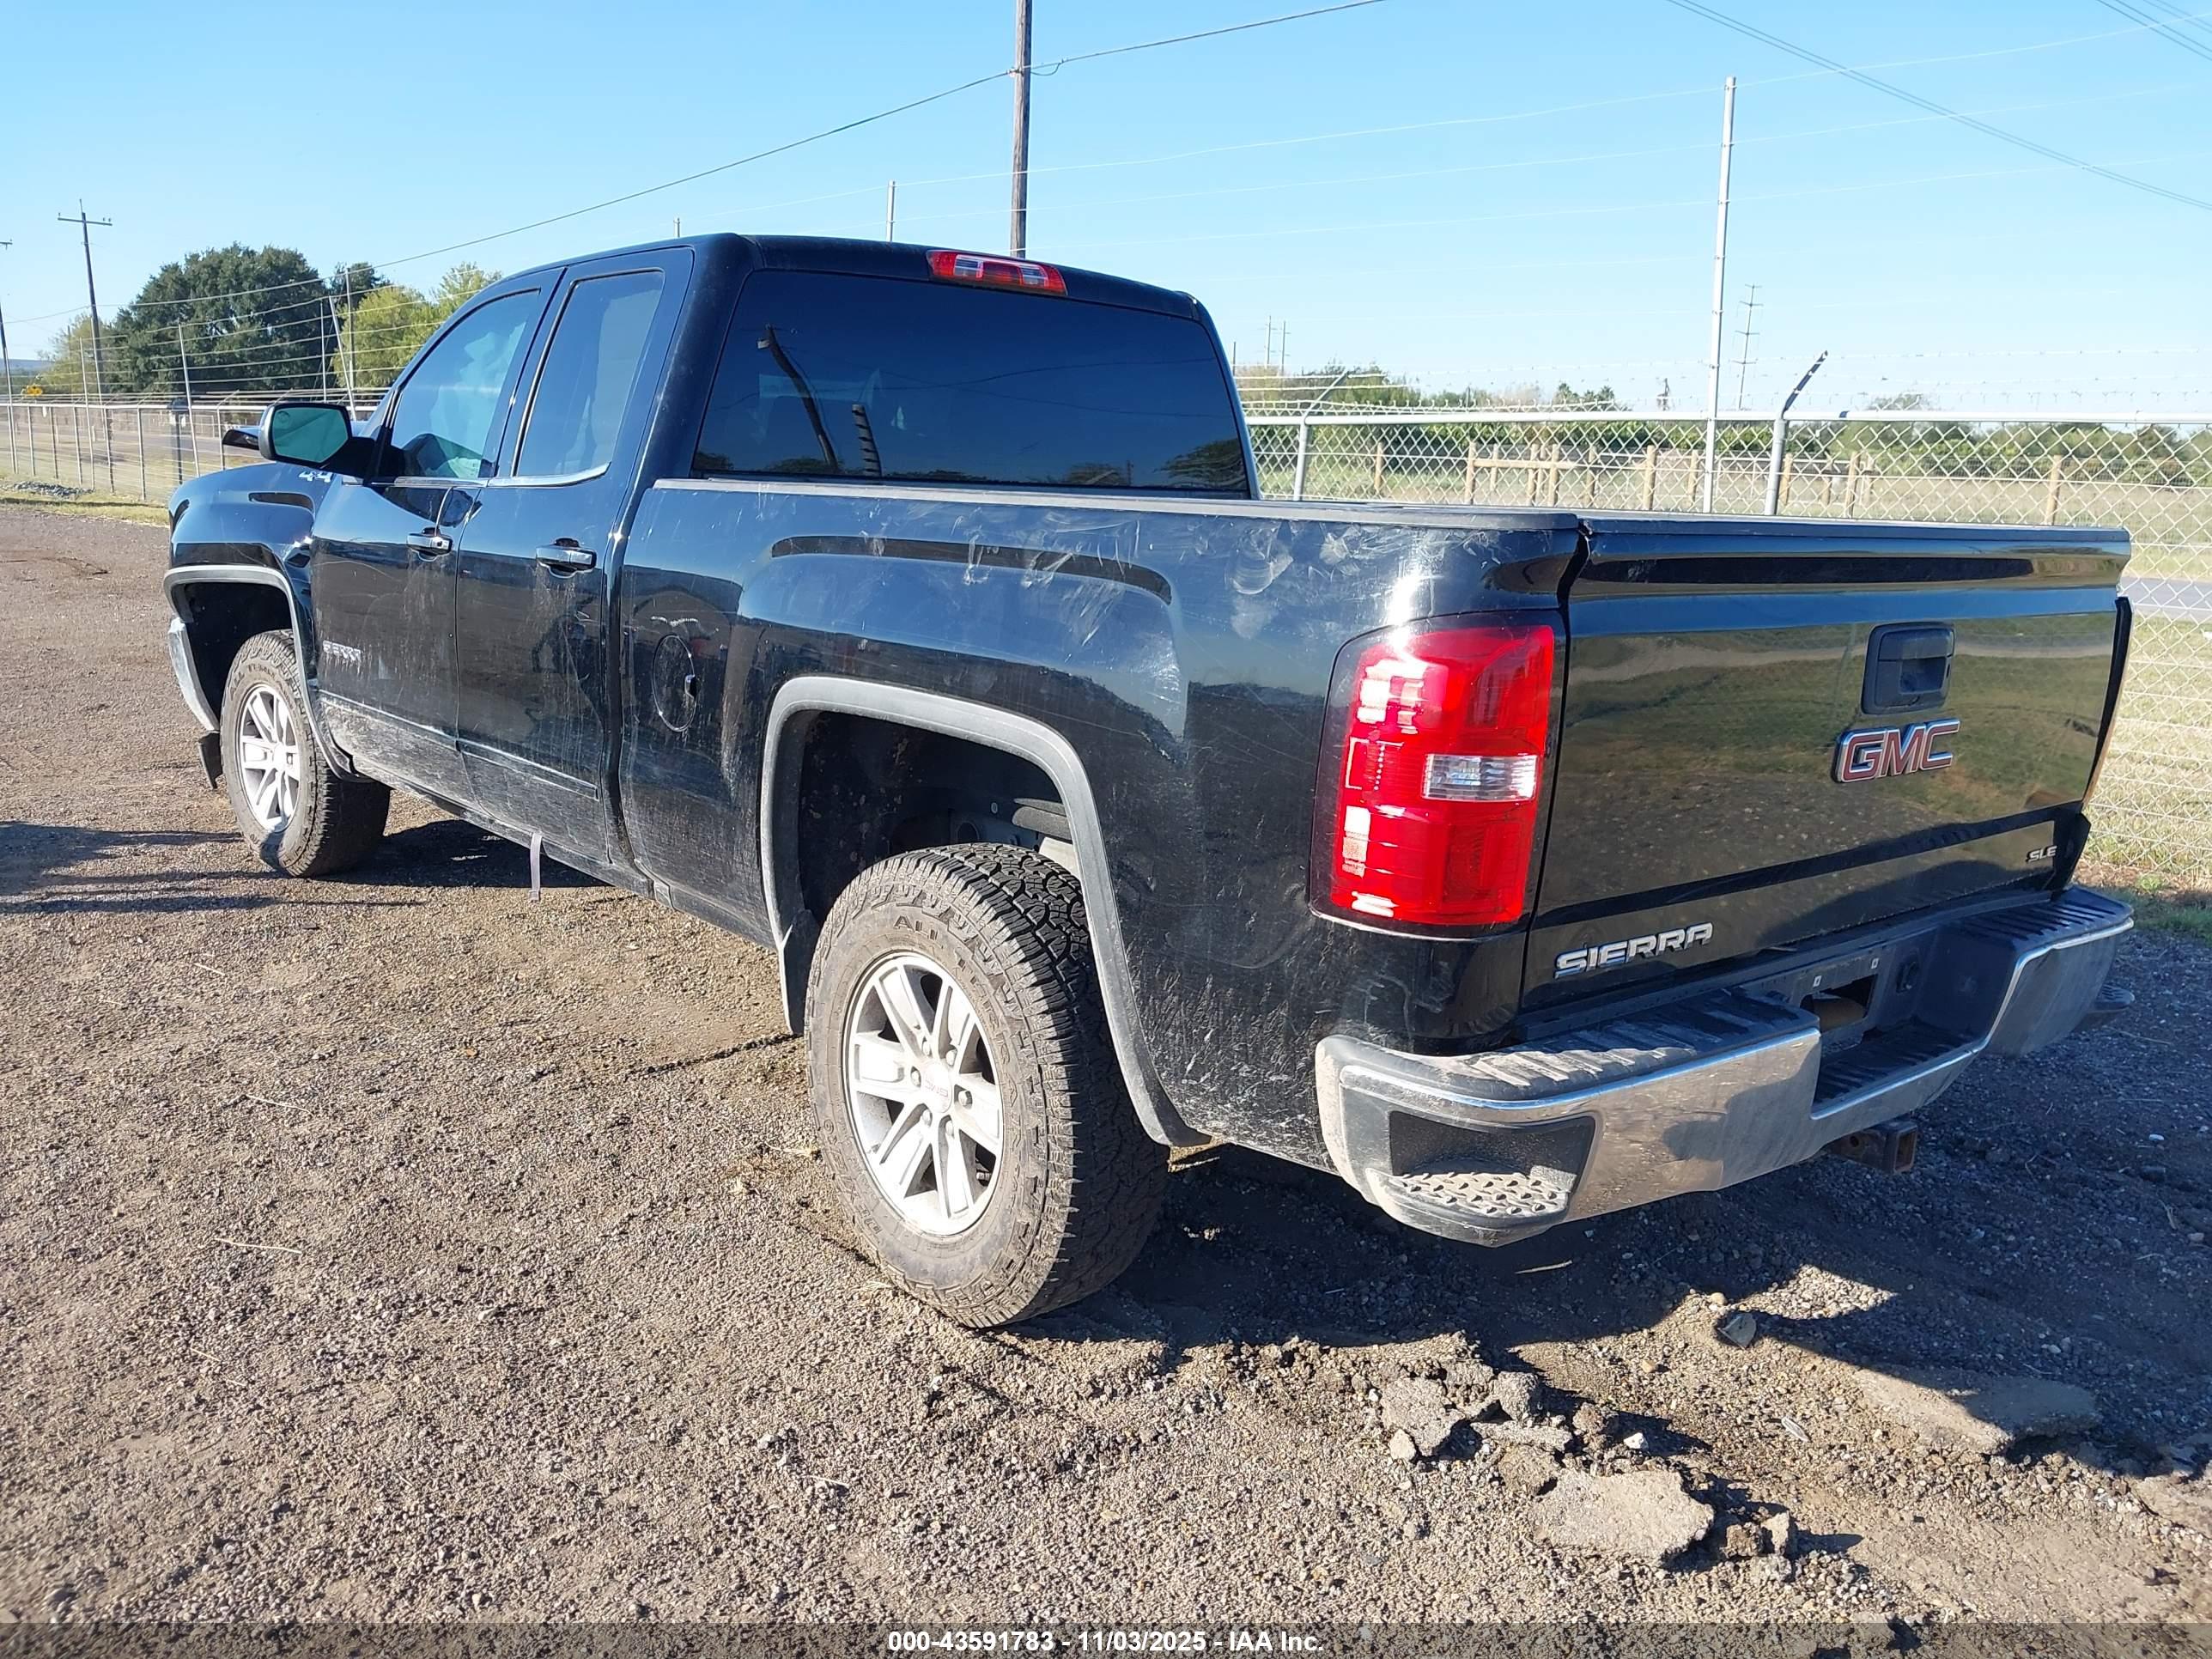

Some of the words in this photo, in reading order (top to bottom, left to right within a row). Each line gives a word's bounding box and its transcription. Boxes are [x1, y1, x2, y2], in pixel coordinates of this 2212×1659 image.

[1831, 718, 1961, 783] GMC
[2027, 845, 2057, 863] SLE
[893, 915, 944, 950] ALL
[1554, 922, 1714, 979] SIERRA
